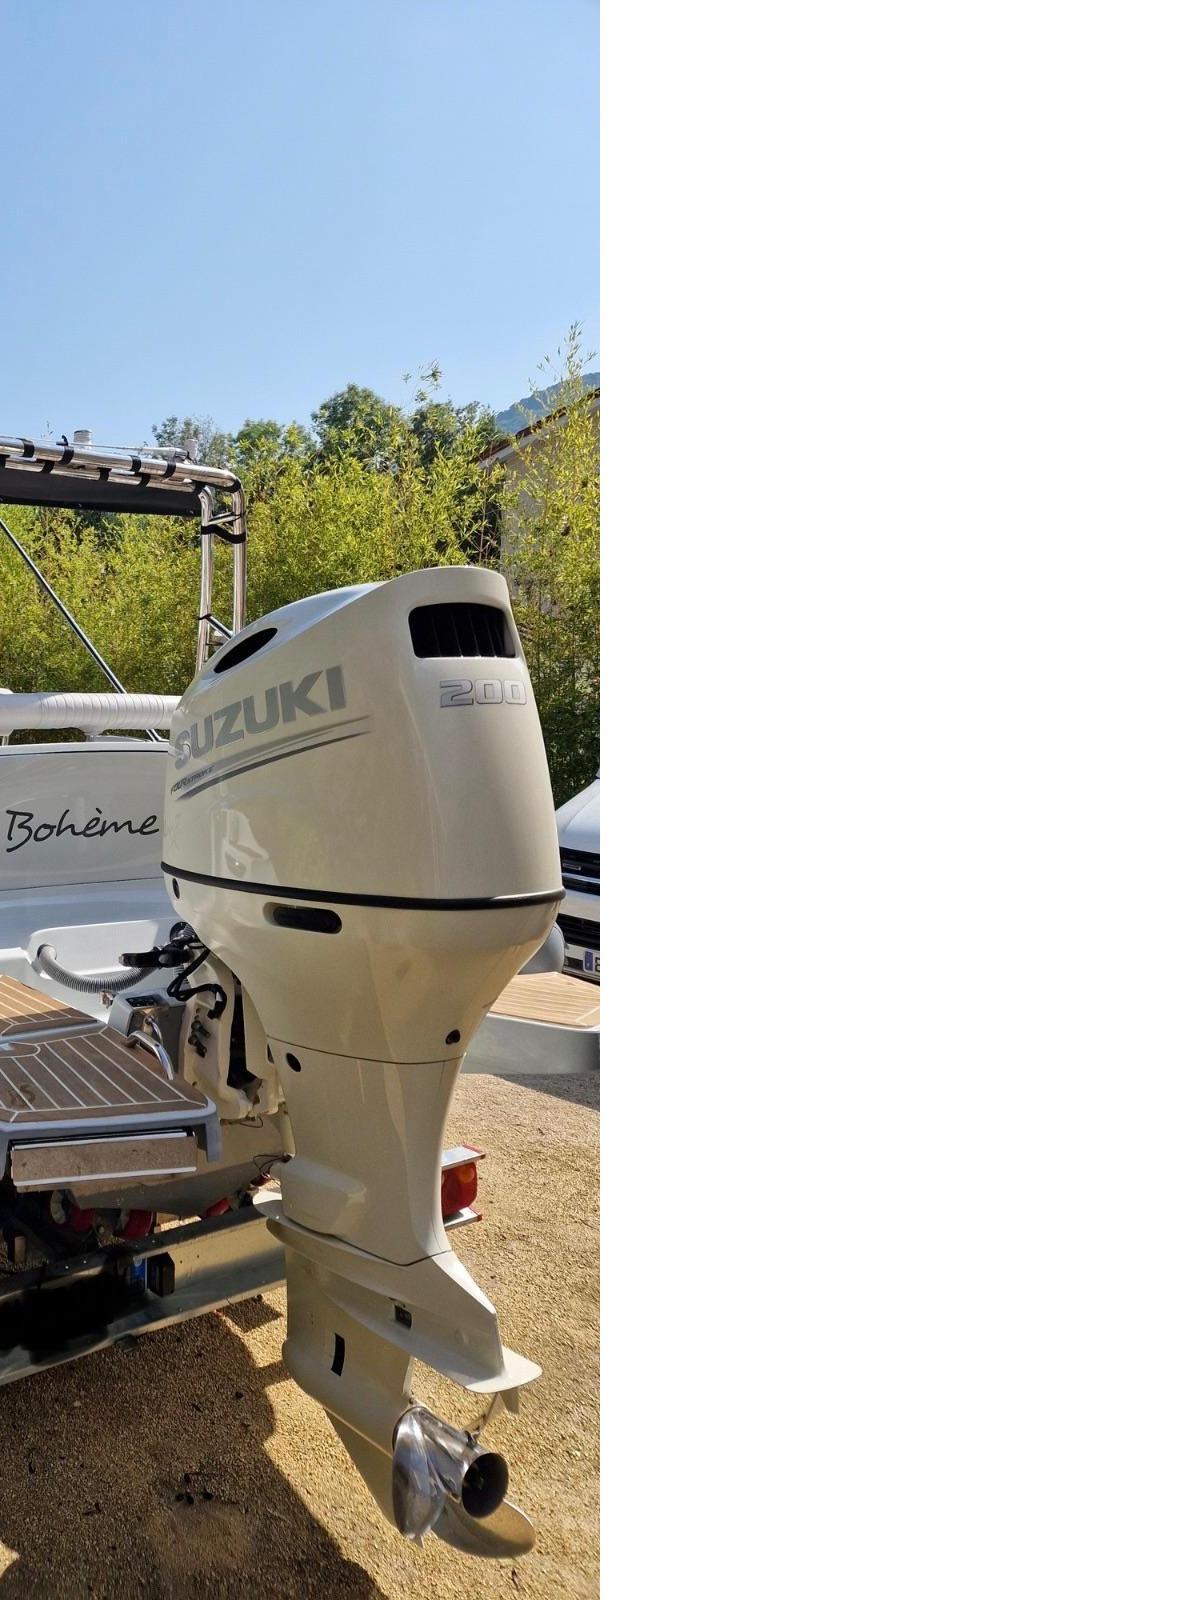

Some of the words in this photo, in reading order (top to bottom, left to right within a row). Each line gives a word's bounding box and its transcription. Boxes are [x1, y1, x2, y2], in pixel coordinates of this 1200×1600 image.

[440, 679, 527, 708] 200
[174, 665, 347, 770] SUZUKI
[5, 807, 160, 853] Bohème
